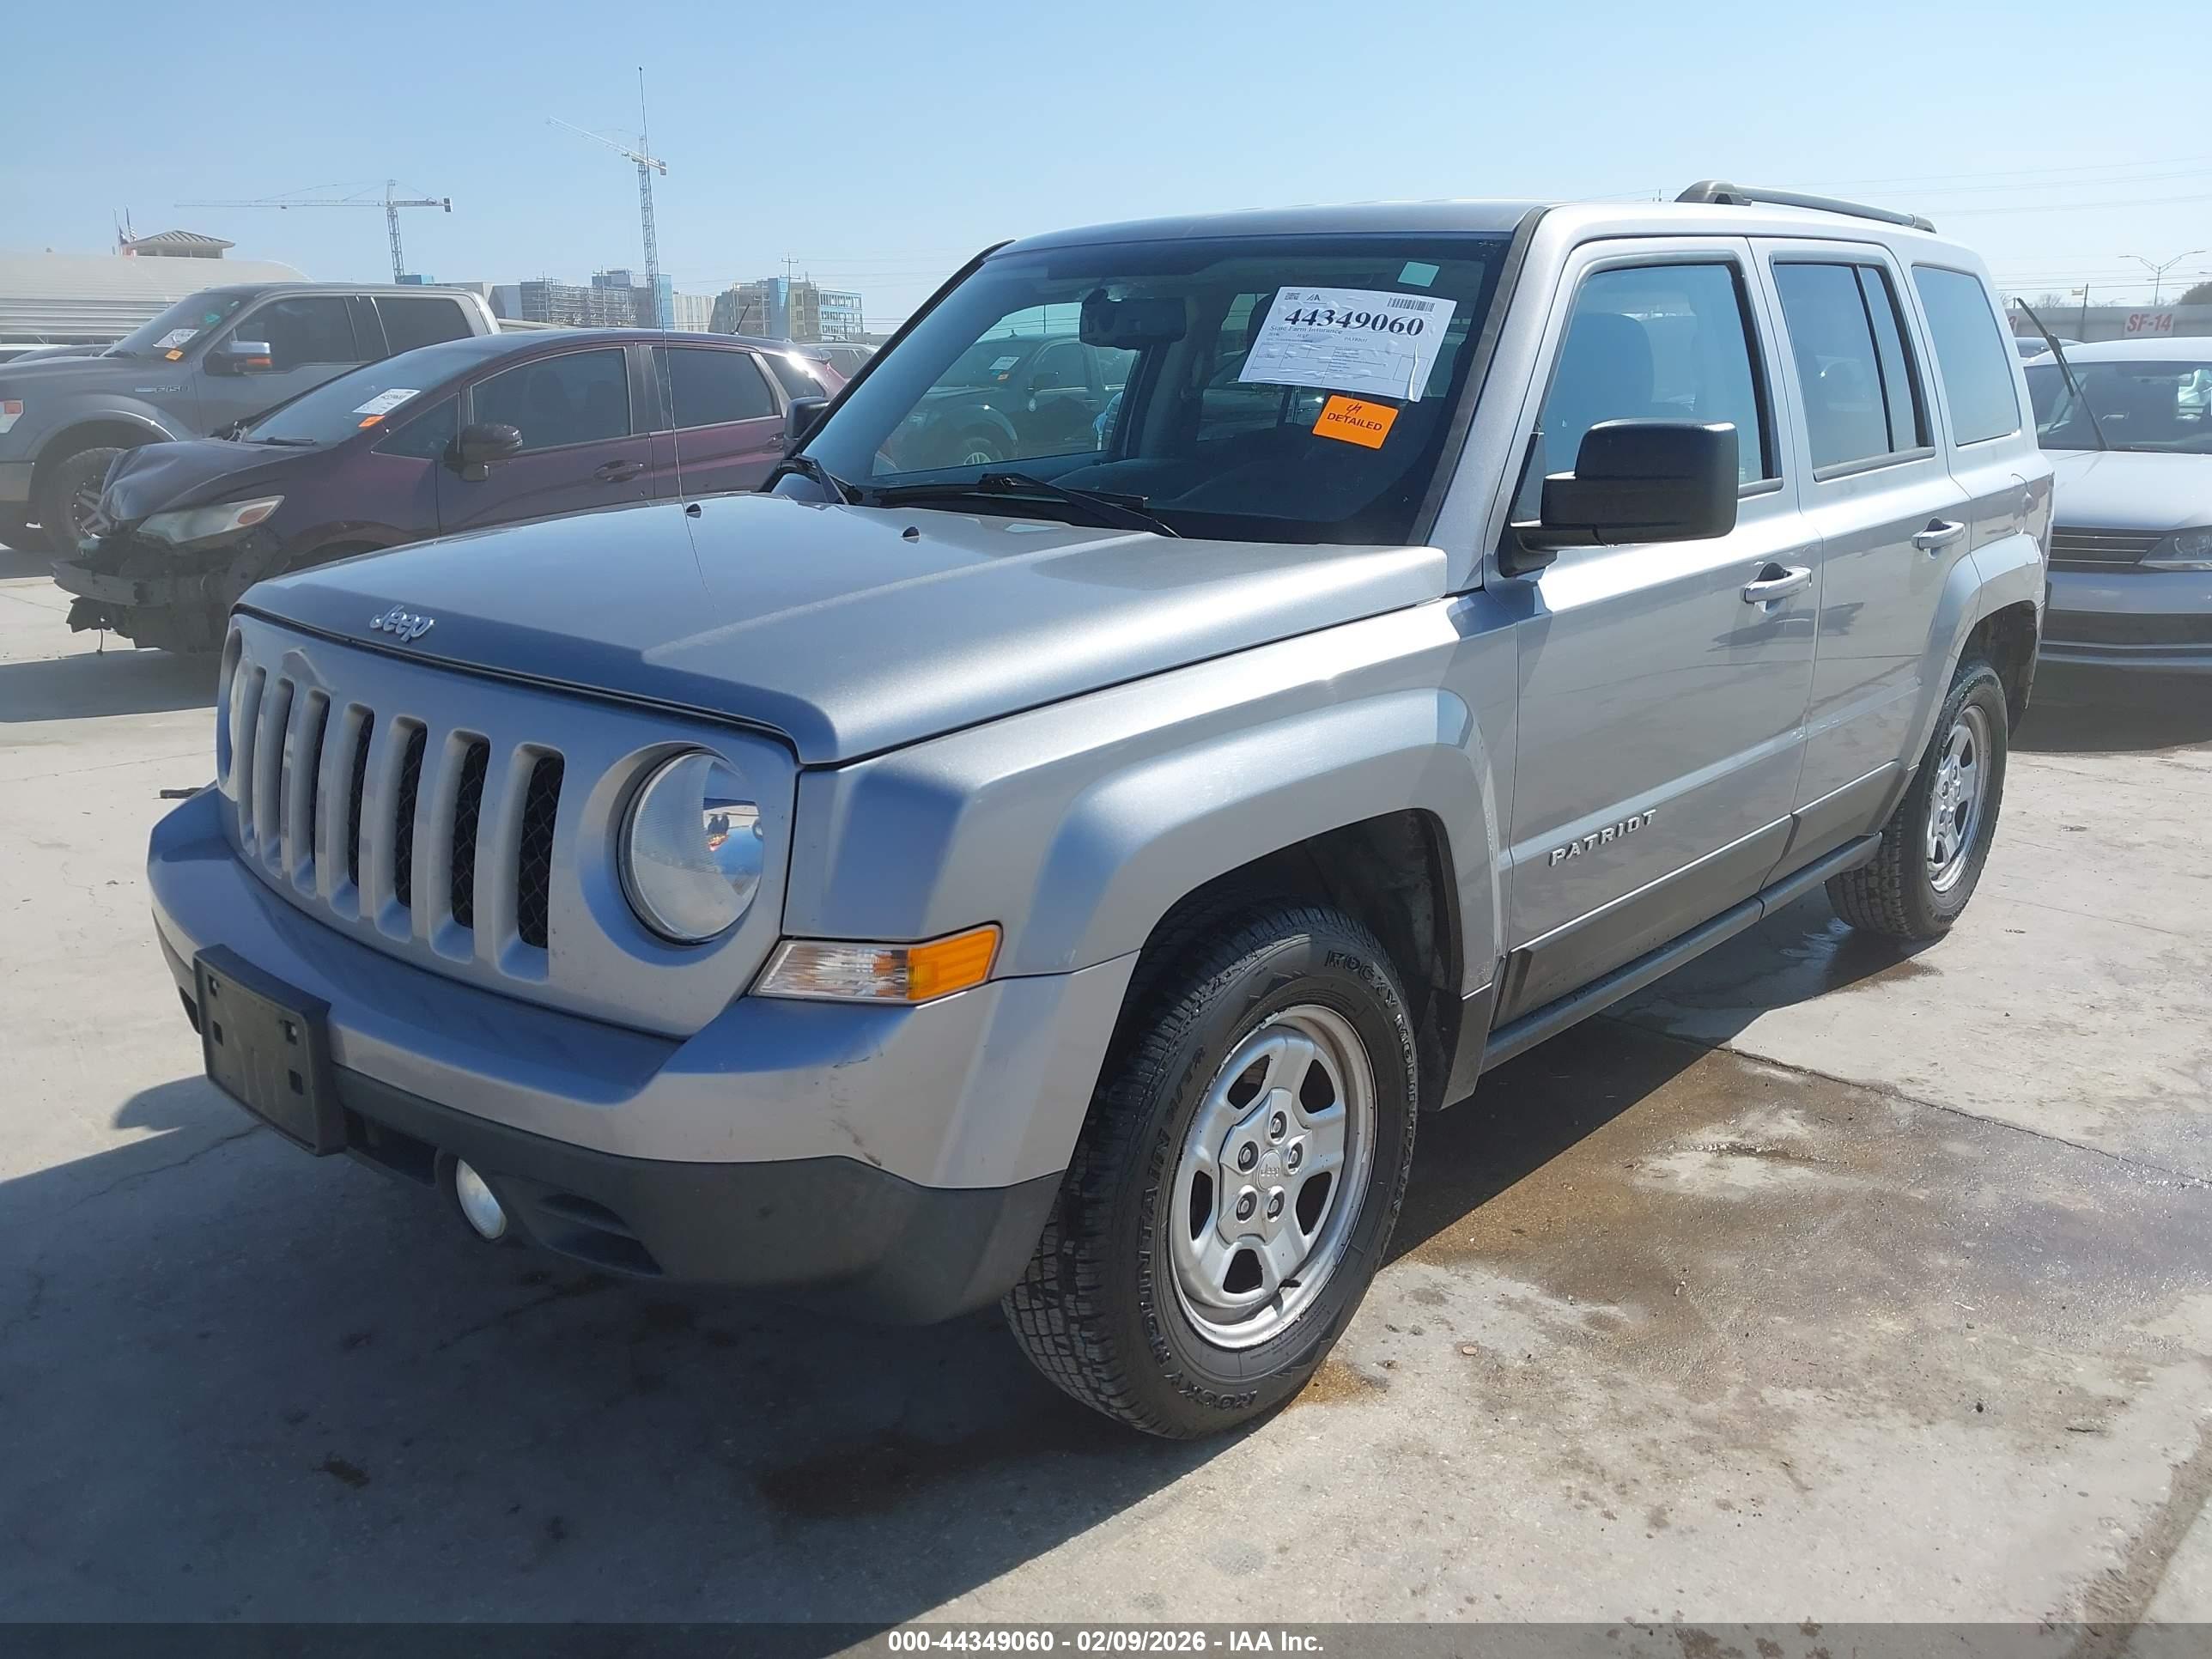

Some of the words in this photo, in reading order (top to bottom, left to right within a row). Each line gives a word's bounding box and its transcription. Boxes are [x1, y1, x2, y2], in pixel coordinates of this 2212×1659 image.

[1284, 307, 1425, 336] 44349060
[1309, 326, 1344, 335] Insurance
[2126, 313, 2172, 333] SF-14
[1327, 412, 1382, 431] DETAILED
[369, 604, 436, 643] Jeep
[1548, 809, 1657, 867] PATRIOT
